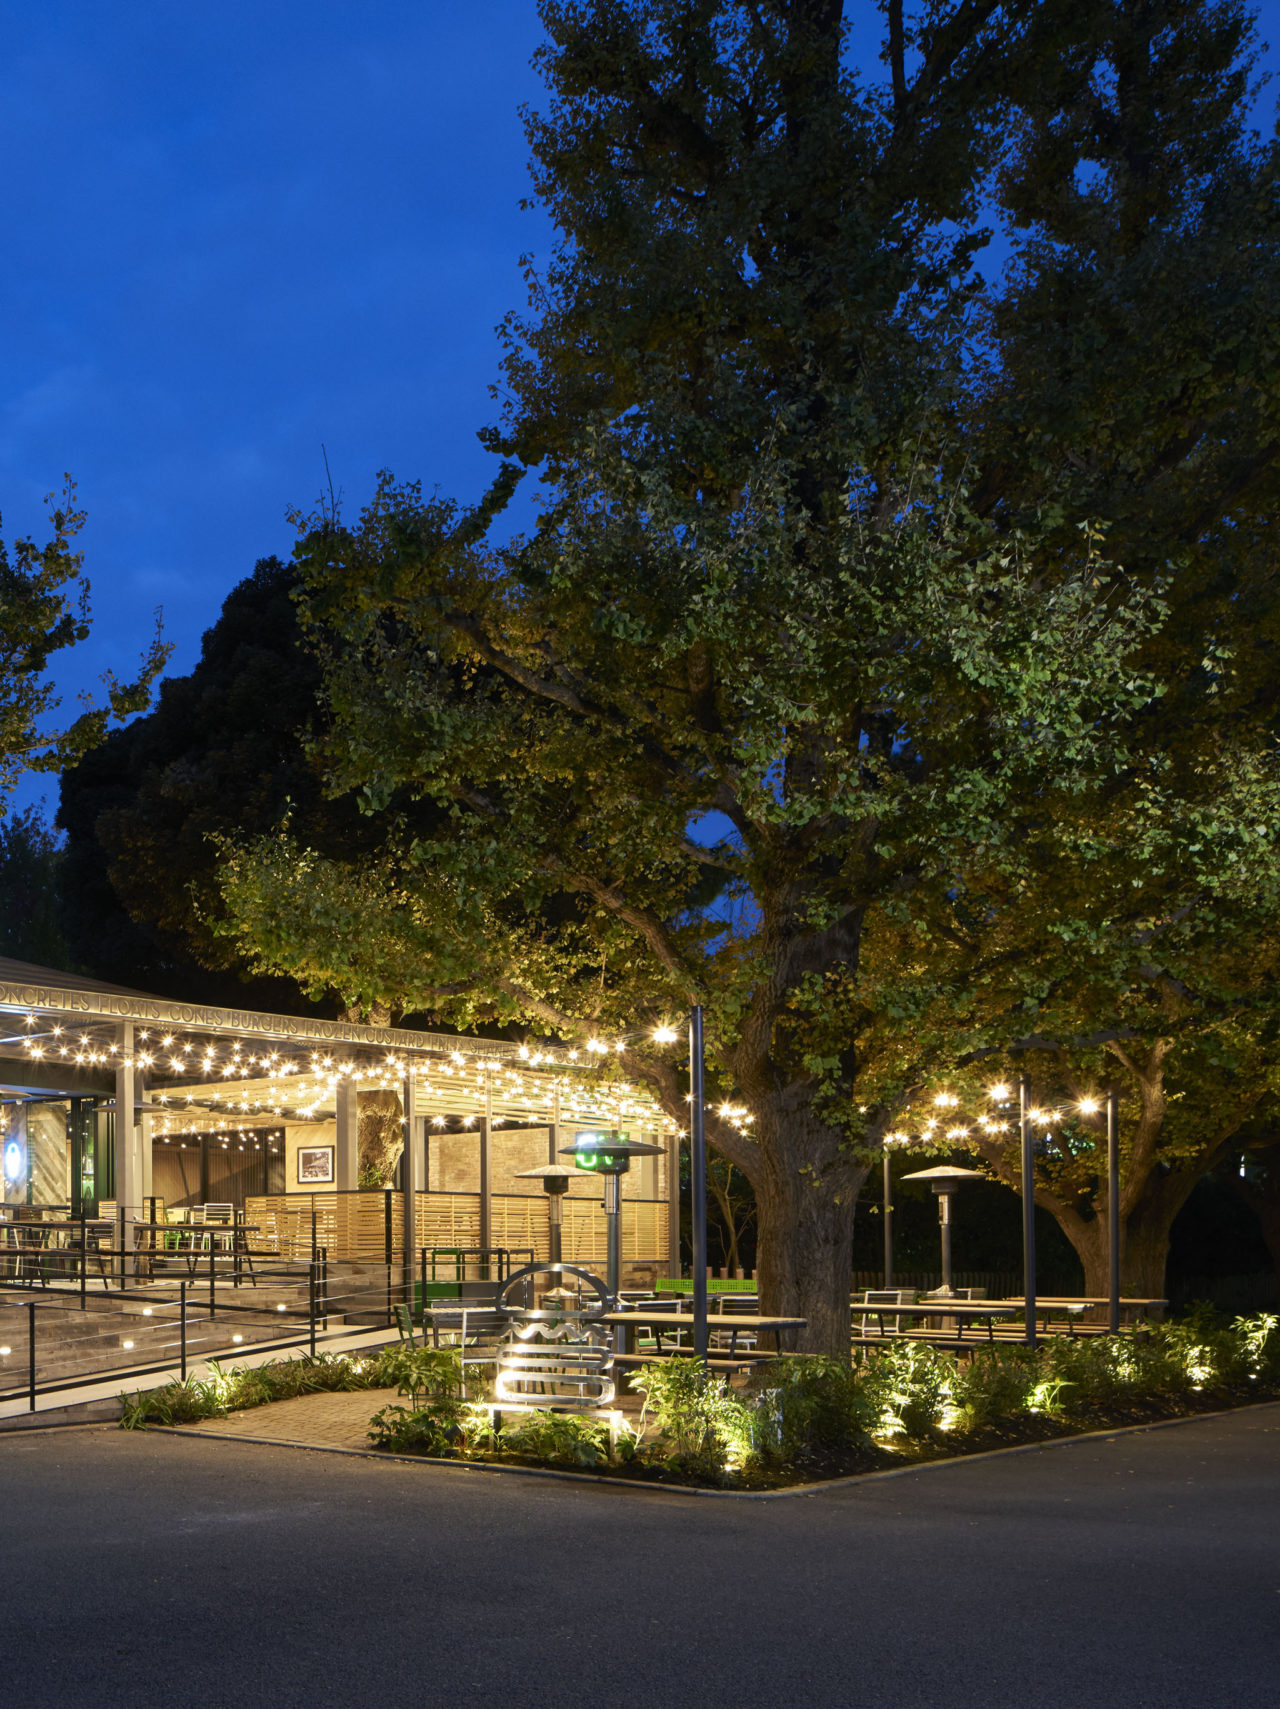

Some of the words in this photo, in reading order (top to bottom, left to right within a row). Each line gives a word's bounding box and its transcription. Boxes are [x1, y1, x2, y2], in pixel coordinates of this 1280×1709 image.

[99, 996, 161, 1019] FLOATS
[170, 1004, 223, 1026] CONES
[231, 1010, 298, 1034] BURGERS
[304, 1019, 361, 1042] FROZEN
[365, 1027, 424, 1048] CUSTARD
